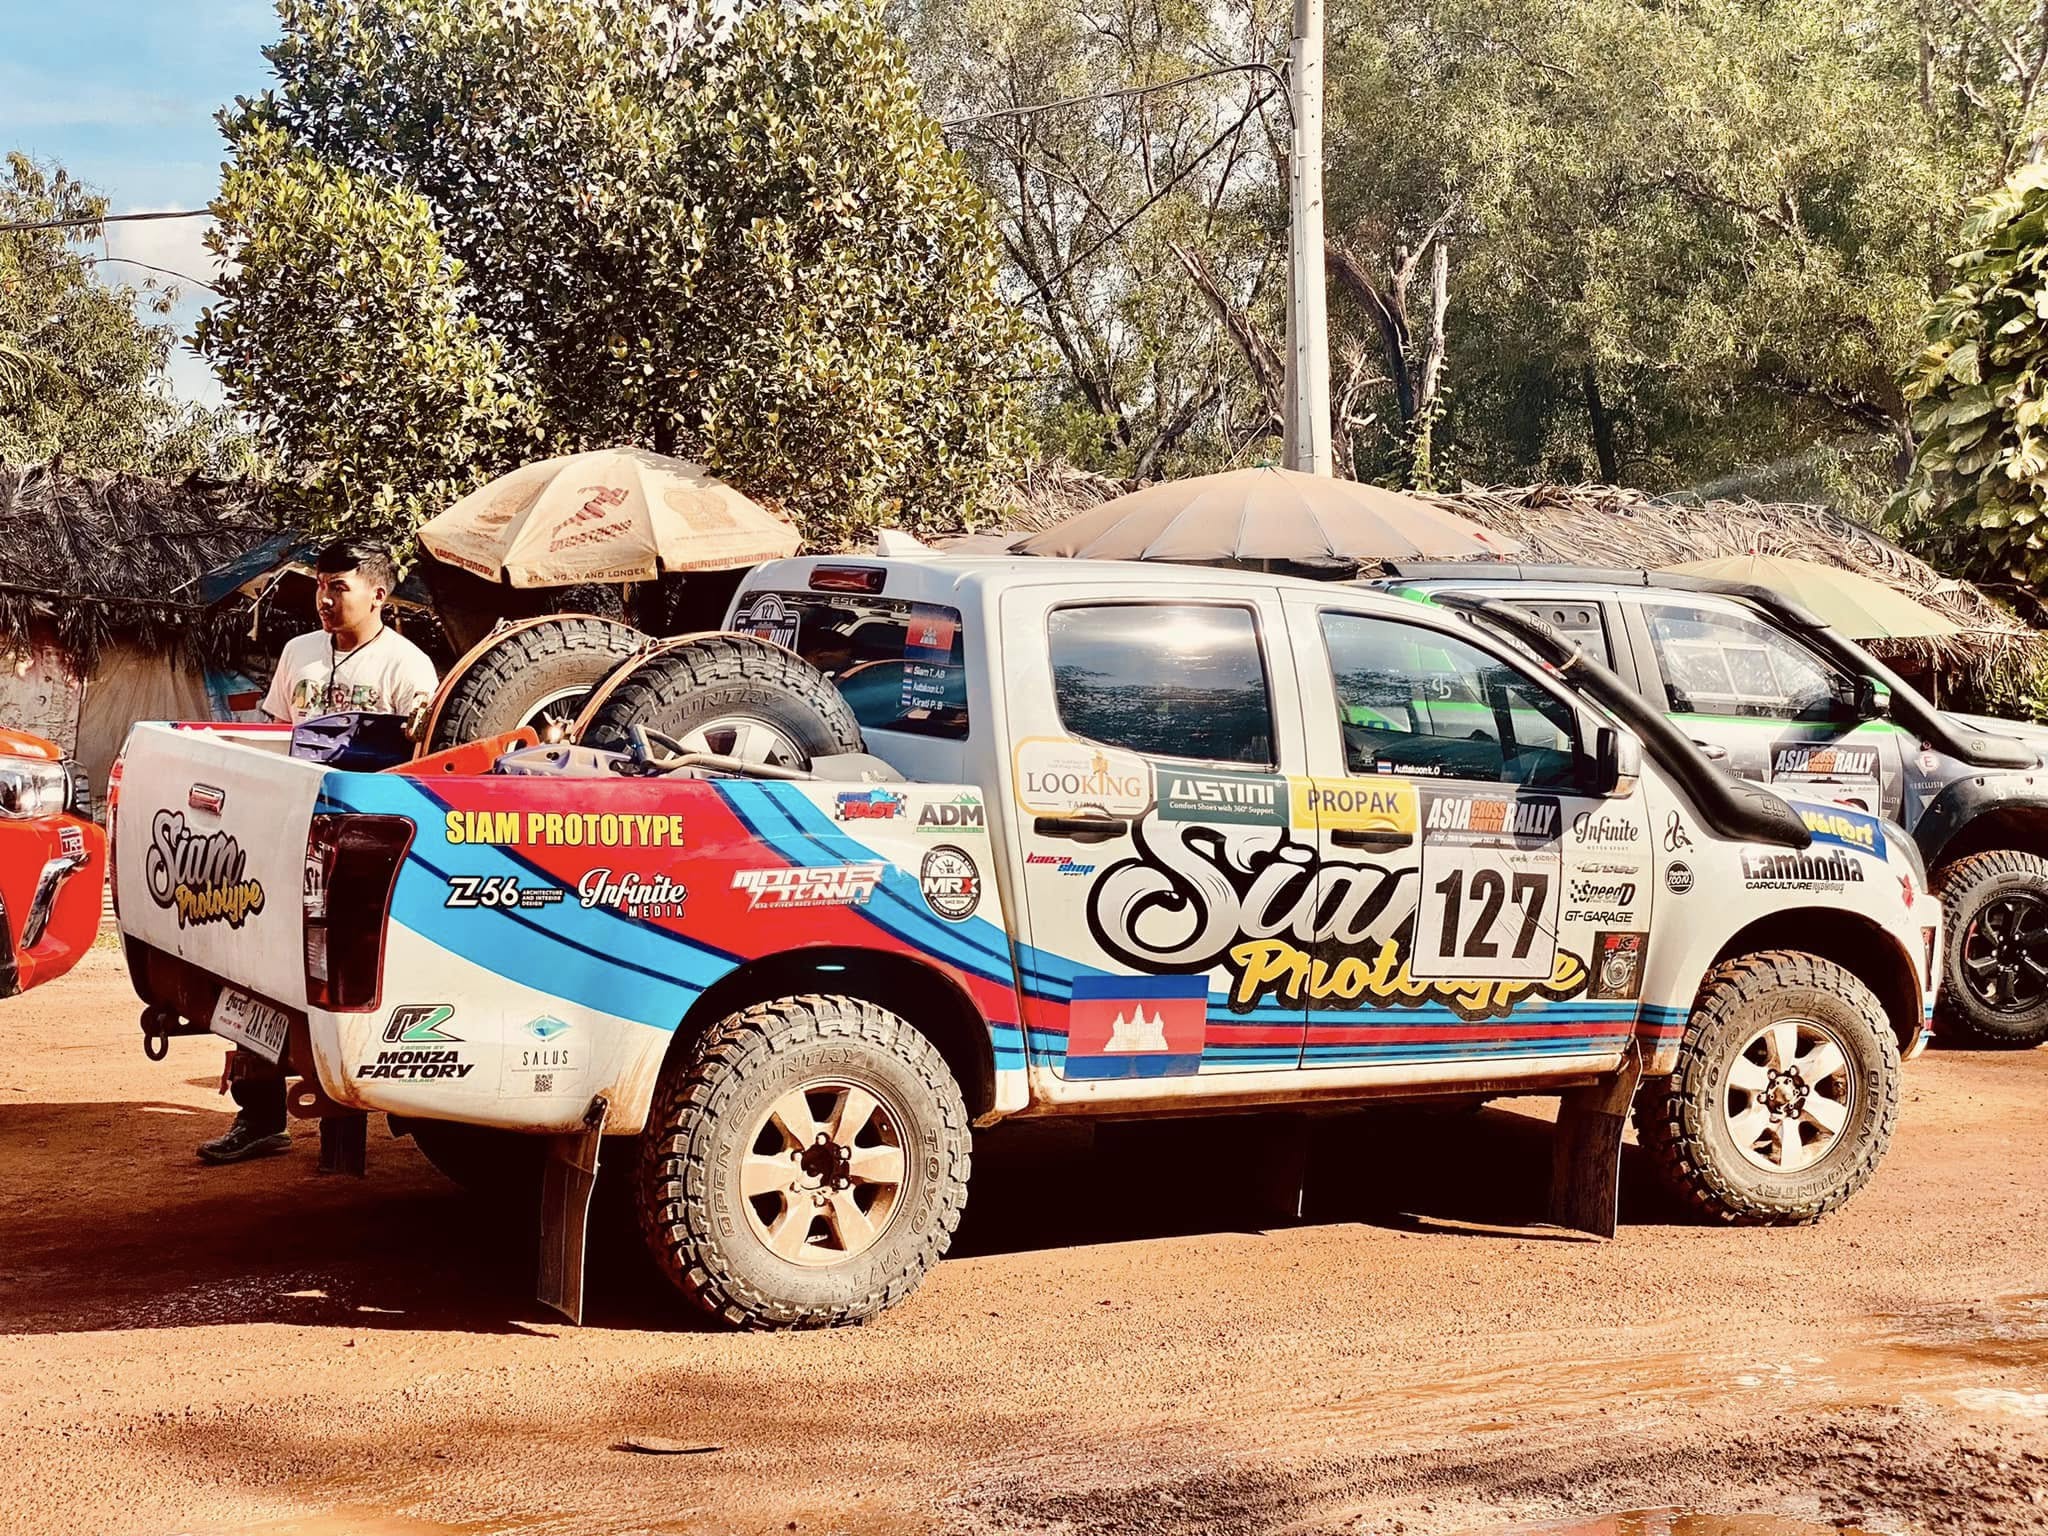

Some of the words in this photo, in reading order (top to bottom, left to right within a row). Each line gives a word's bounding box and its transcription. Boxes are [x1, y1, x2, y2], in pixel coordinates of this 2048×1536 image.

[585, 571, 604, 580] AND
[608, 567, 646, 578] LONGER
[761, 604, 775, 619] 127
[1775, 749, 1809, 772] ASIA
[1833, 751, 1875, 774] RALLY
[1026, 771, 1142, 798] LOOKING
[845, 801, 898, 819] FAST
[1169, 801, 1197, 810] Comfort
[1198, 803, 1217, 812] Shoes
[1217, 804, 1233, 813] with
[1249, 806, 1274, 815] Support
[1307, 788, 1401, 815] PROPAK
[1425, 797, 1473, 830] ASIA
[1471, 800, 1507, 818] CROSS
[918, 804, 984, 826] ADM
[1469, 818, 1505, 832] COUNTRY
[1501, 801, 1558, 835] RALLY
[1573, 811, 1640, 844] Infinite
[446, 811, 519, 844] SIAM
[527, 813, 685, 847] PROTOTYPE
[146, 809, 246, 909] Siam
[1057, 861, 1096, 876] shop
[1739, 847, 1865, 882] Cambodia
[578, 868, 687, 909] Infinite
[731, 865, 884, 888] MONSTER
[923, 877, 980, 894] MRX
[1745, 881, 1813, 890] CARCULTURE
[174, 878, 265, 930] Prototype
[446, 877, 519, 906] Z56
[628, 904, 685, 919] MEDIA
[1436, 868, 1550, 959] 127
[1564, 910, 1635, 926] GT-GARAGE
[376, 1051, 459, 1064] MONZA
[523, 1050, 569, 1066] SALUS
[356, 1064, 475, 1079] FACTORY
[729, 1048, 861, 1133] COUNTRY
[1857, 1070, 1880, 1147] OPEN
[713, 1143, 736, 1238] OPEN
[911, 1128, 940, 1235] TOYO
